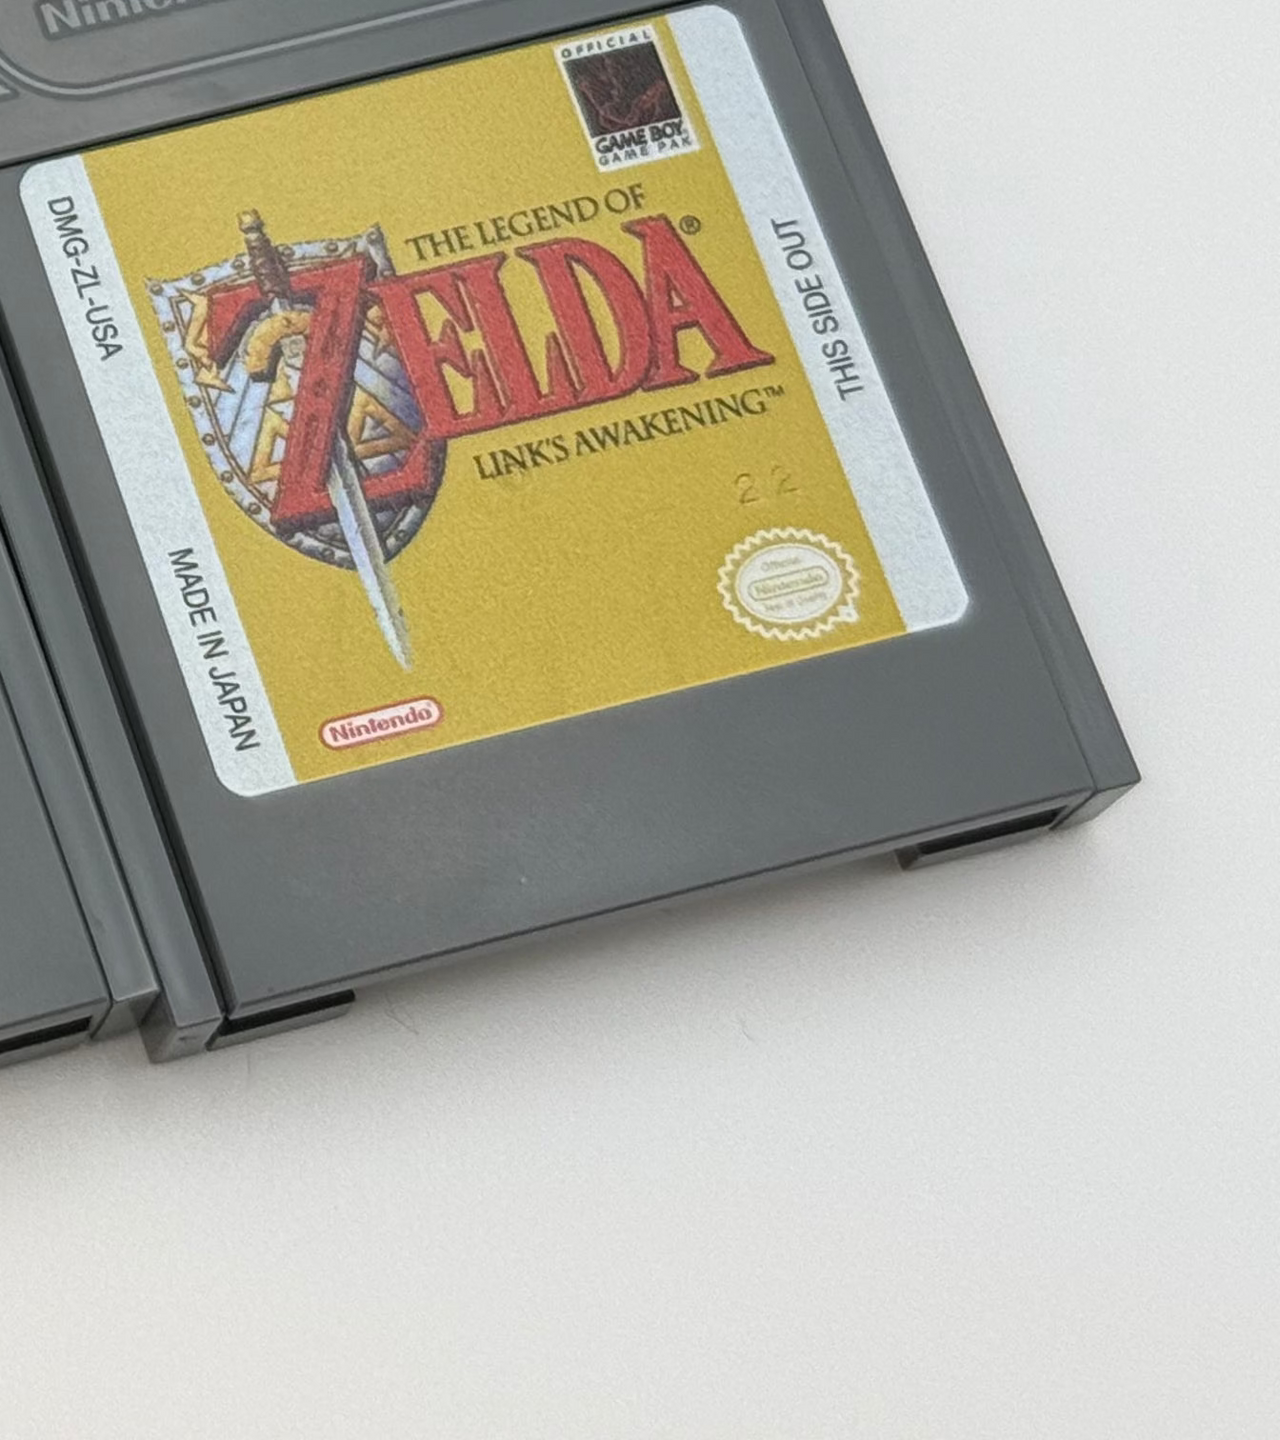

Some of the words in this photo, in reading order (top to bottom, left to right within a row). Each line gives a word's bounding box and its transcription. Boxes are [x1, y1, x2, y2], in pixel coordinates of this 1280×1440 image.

[561, 30, 651, 58] OFFICIAL
[596, 127, 648, 155] GAME
[649, 120, 684, 141] BOY
[599, 147, 649, 166] GAME
[406, 227, 473, 262] THE
[474, 197, 600, 250] LEGEND
[598, 182, 647, 220] OF
[770, 217, 813, 271] OUT
[47, 196, 124, 361] DMG-ZL-USA
[794, 273, 839, 335] SIDE
[206, 212, 776, 532] ZELDA
[821, 339, 864, 402] THIS
[472, 432, 570, 482] LINK'S
[574, 390, 767, 456] AWAKENING
[167, 547, 218, 629] MADE
[196, 629, 229, 661] IN
[208, 665, 261, 753] JAPAN
[328, 706, 433, 742] Nintendo
